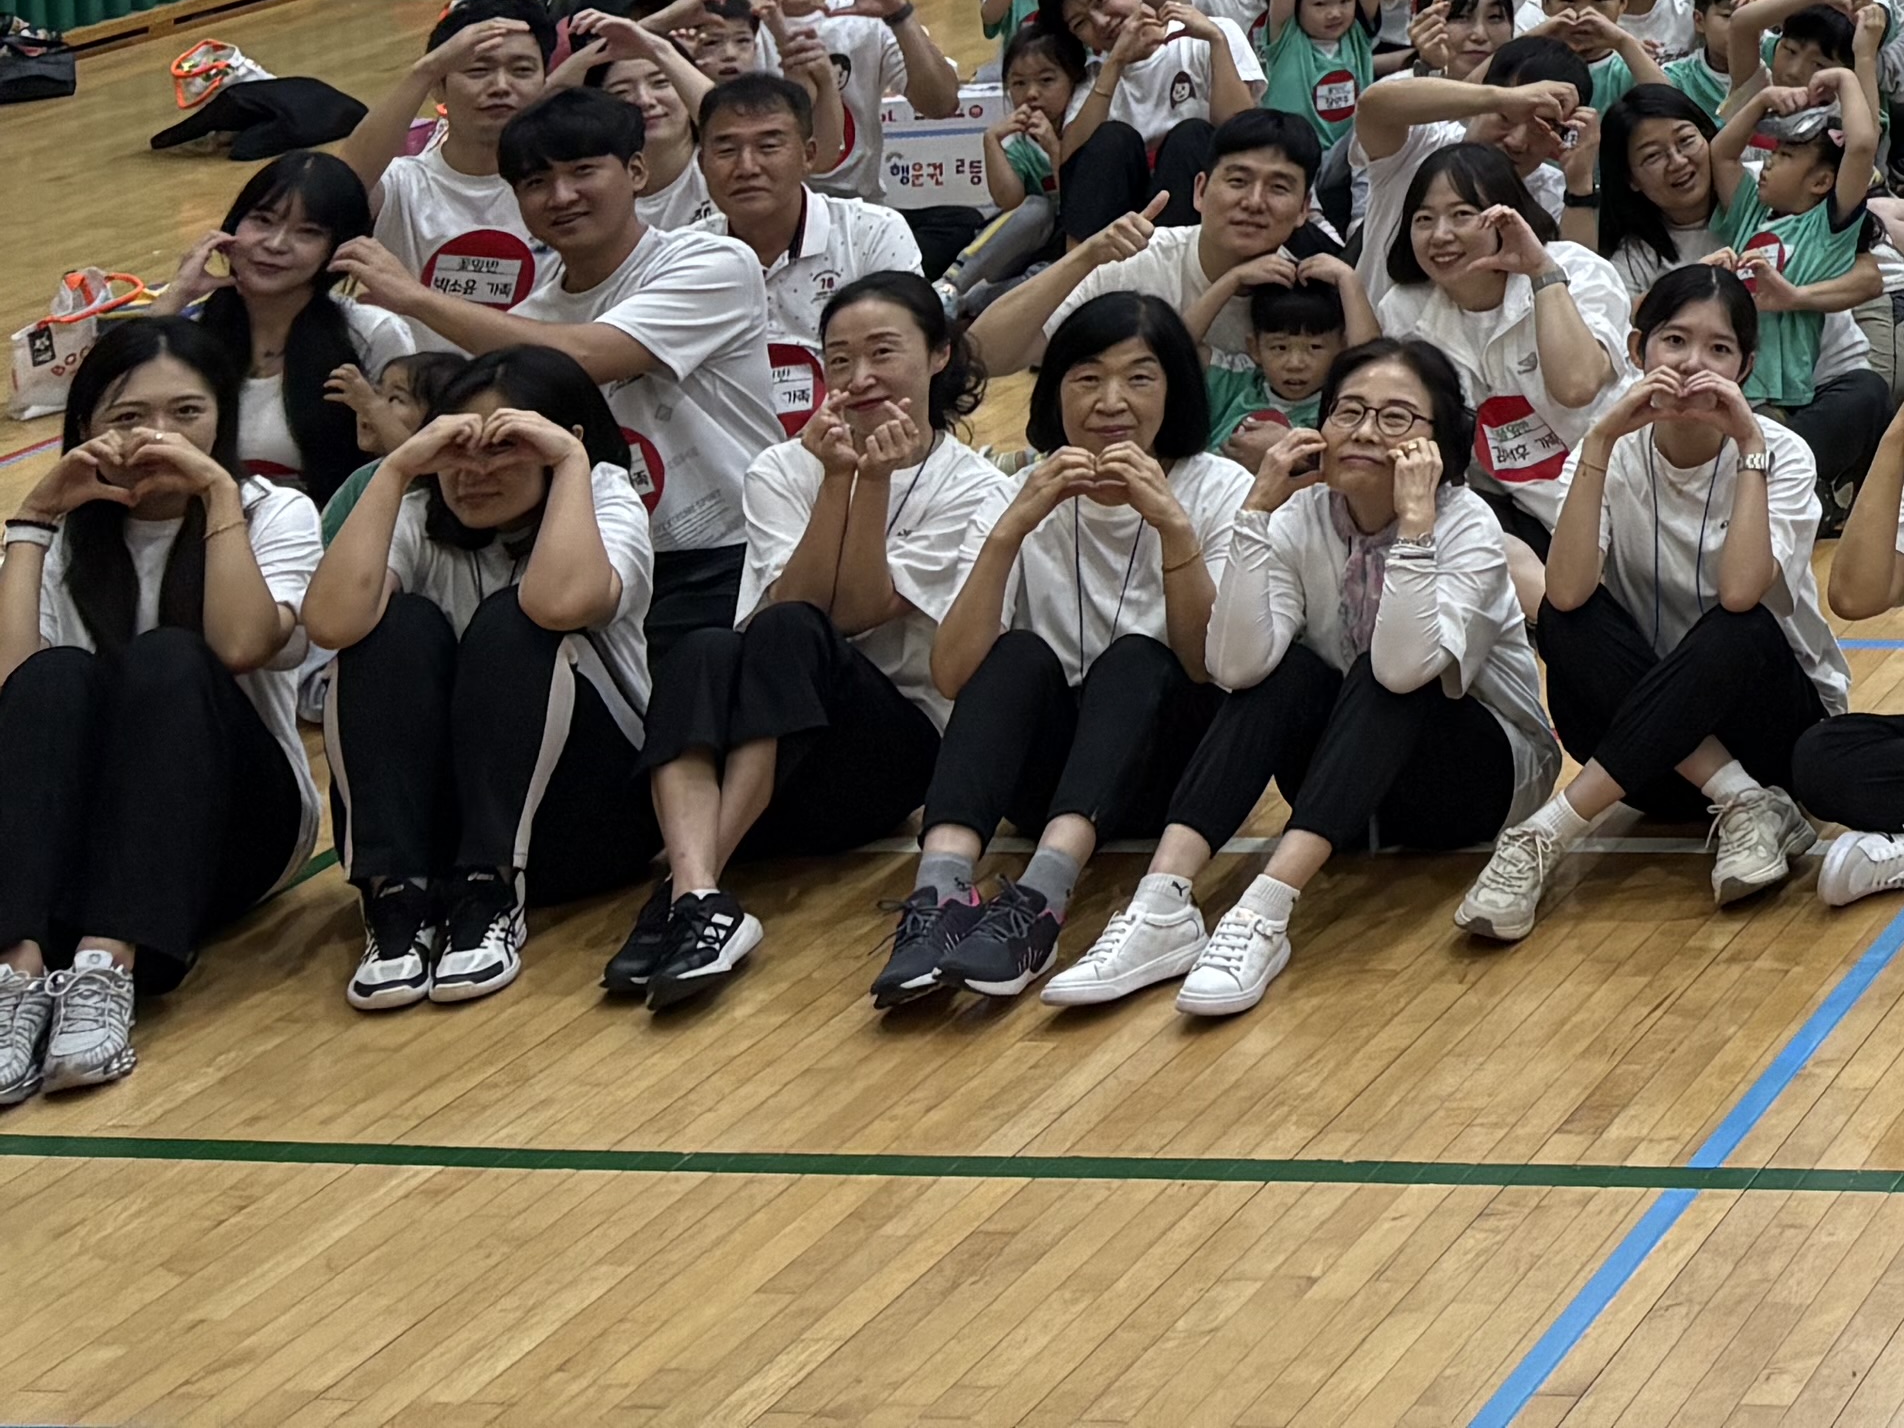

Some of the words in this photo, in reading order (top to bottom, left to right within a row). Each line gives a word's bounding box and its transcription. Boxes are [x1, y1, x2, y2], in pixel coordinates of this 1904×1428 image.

[890, 161, 945, 188] 행운권
[487, 281, 514, 298] 가족
[782, 387, 812, 404] 가족
